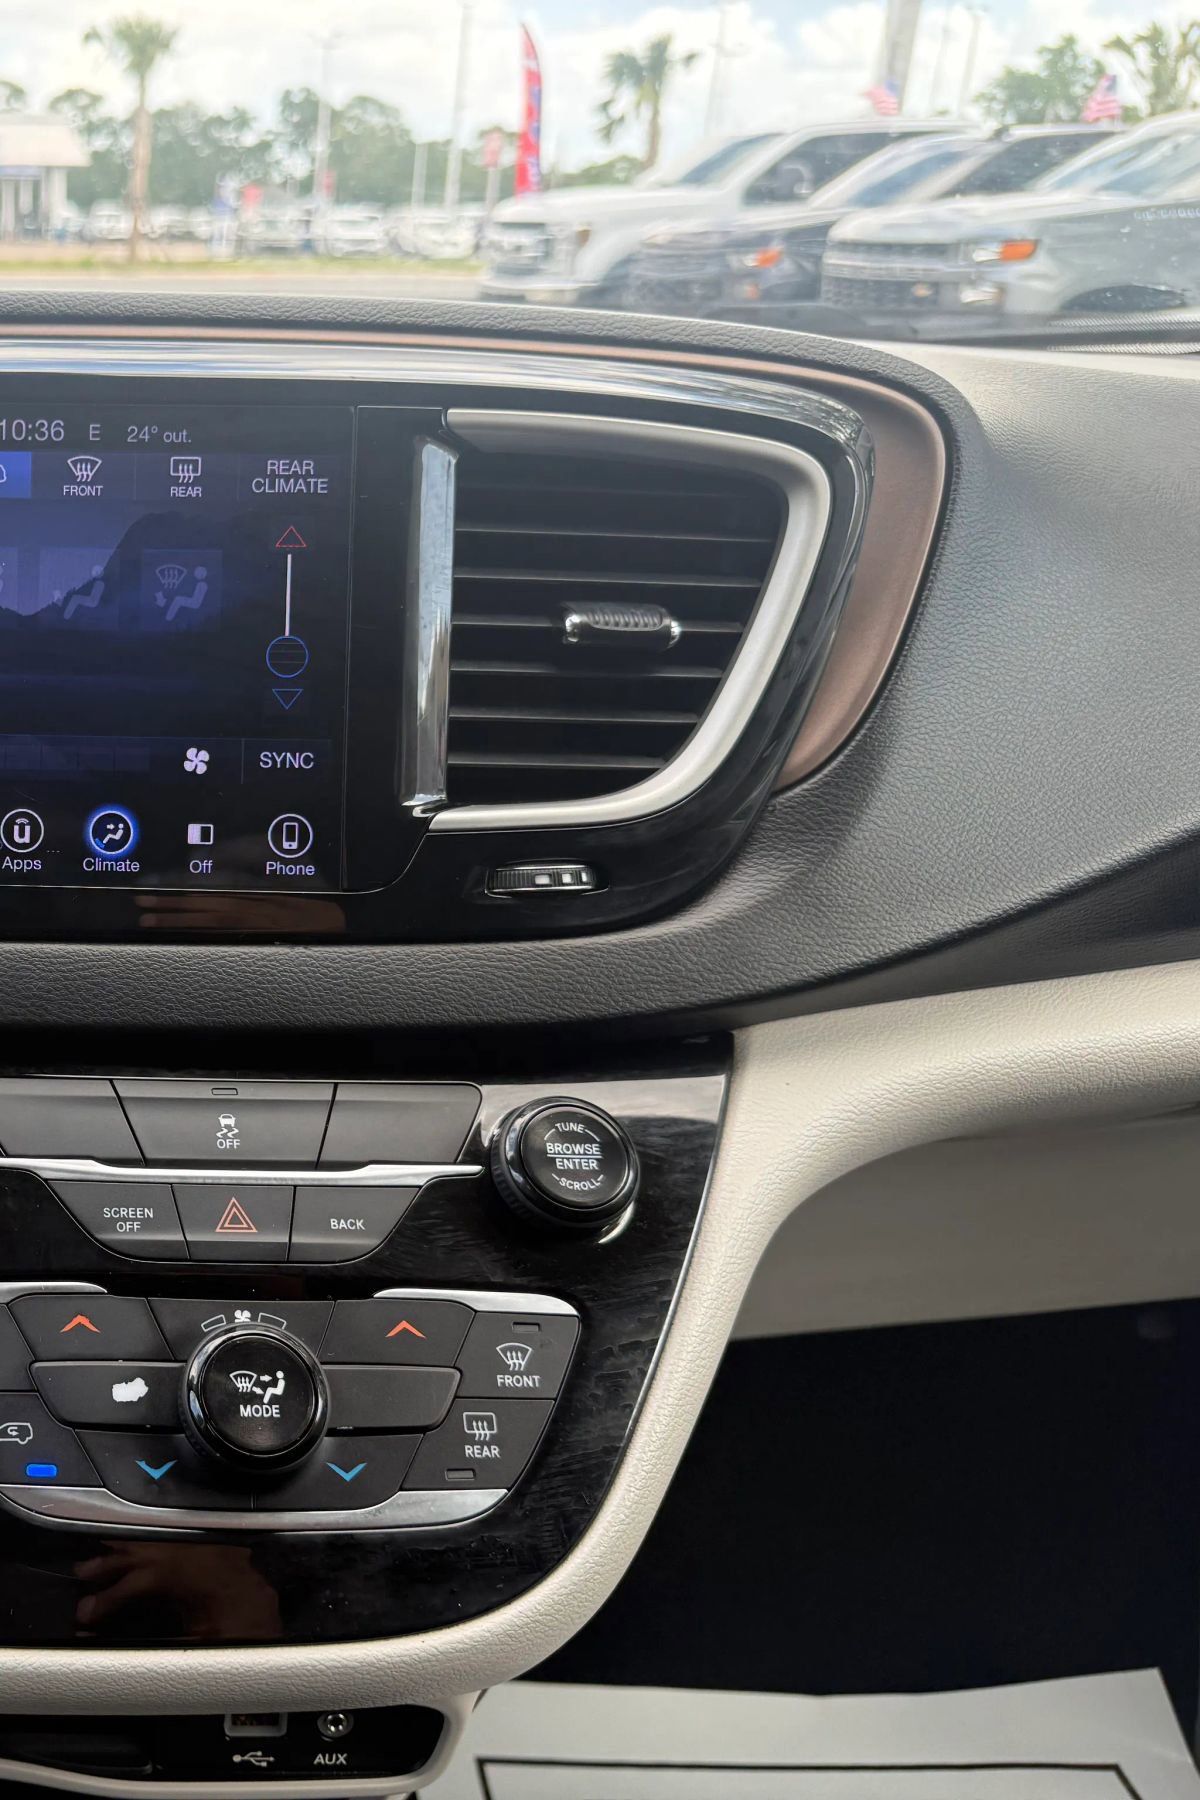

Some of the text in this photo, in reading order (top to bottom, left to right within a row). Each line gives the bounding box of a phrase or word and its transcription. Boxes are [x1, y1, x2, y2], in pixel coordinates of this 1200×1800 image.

[89, 424, 101, 441] E
[163, 427, 192, 443] out.
[267, 461, 315, 475] REAR
[63, 485, 103, 497] FRONT
[170, 486, 202, 498] REAR
[251, 478, 328, 495] CLIMATE
[259, 751, 315, 769] SYNC
[1, 857, 42, 873] Apps
[82, 857, 140, 873] Climate
[189, 860, 213, 874] Off
[265, 861, 315, 876] Phone
[555, 1121, 585, 1134] TUNE
[216, 1138, 241, 1150] OFF
[546, 1142, 602, 1155] BROWSE
[555, 1158, 599, 1170] ENTER
[559, 1177, 601, 1191] SCROLL
[103, 1207, 154, 1220] SCREEN
[116, 1221, 142, 1233] OFF
[330, 1218, 366, 1231] BACK
[496, 1374, 541, 1388] FRONT
[239, 1404, 281, 1418] MODE
[464, 1445, 500, 1459] REAR
[313, 1752, 348, 1766] AUX
